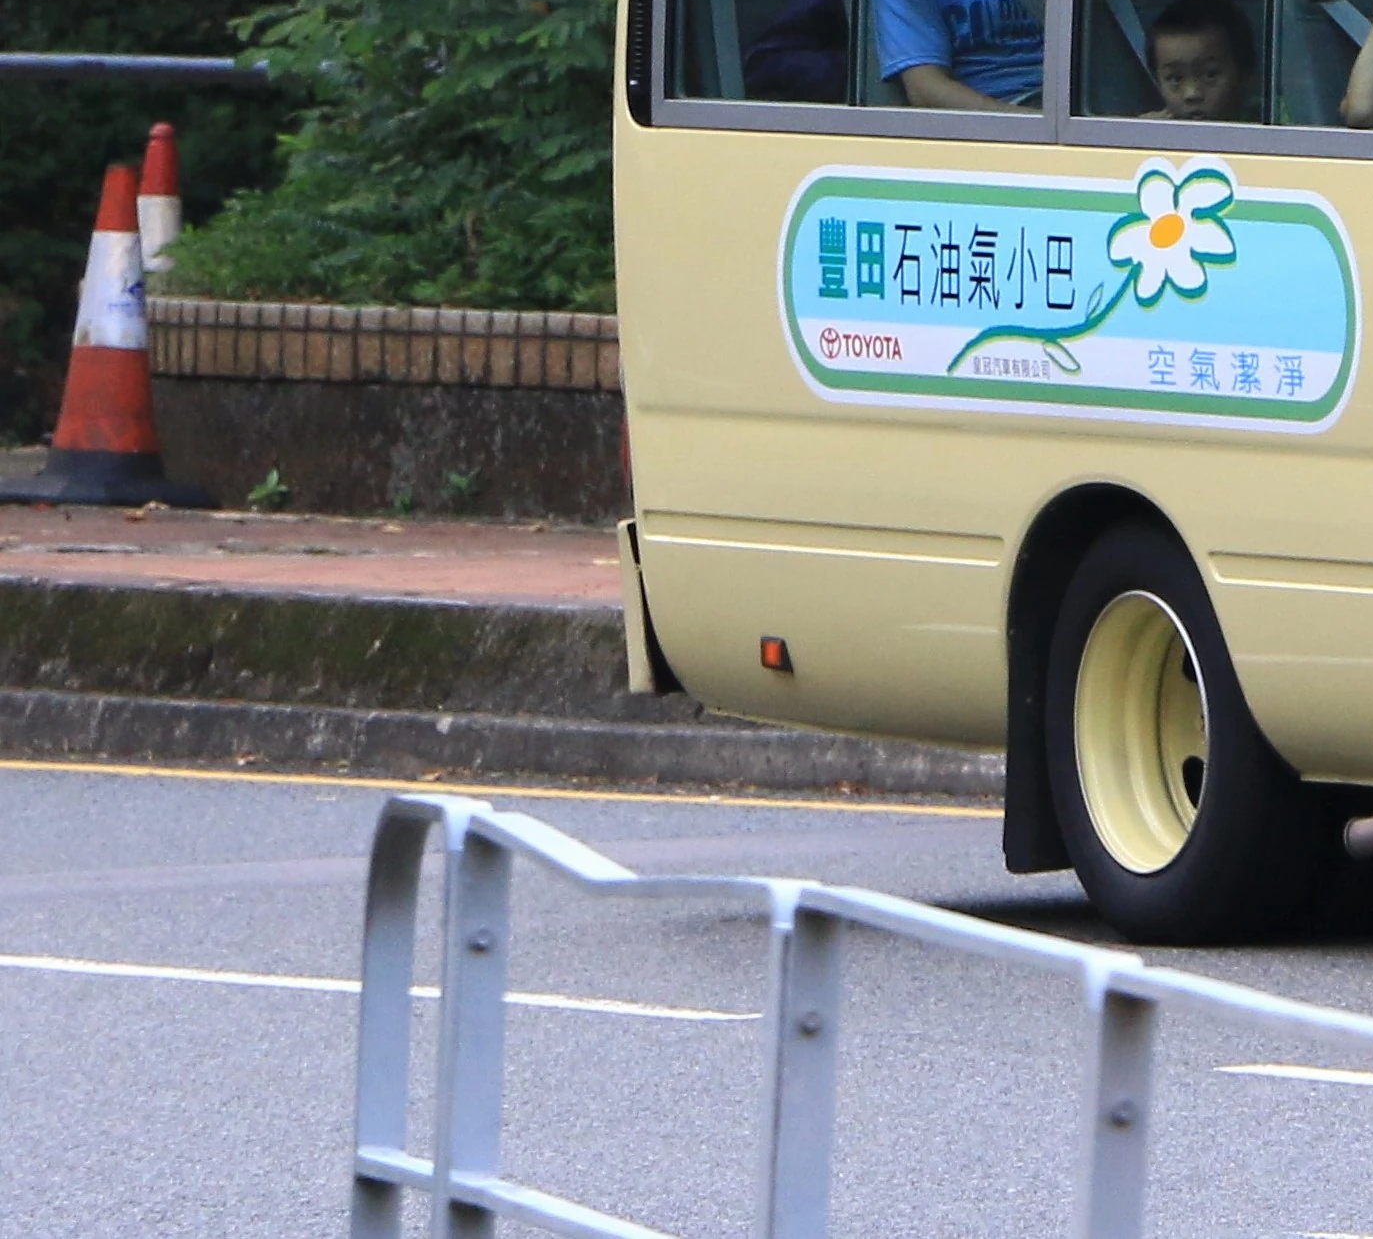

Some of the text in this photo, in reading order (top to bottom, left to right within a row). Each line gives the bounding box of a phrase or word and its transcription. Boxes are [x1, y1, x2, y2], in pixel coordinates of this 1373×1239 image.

[817, 216, 1077, 311] 豐田石油氣小巴
[842, 332, 903, 362] TOYOTA
[1147, 343, 1306, 398] 空氣潔淨
